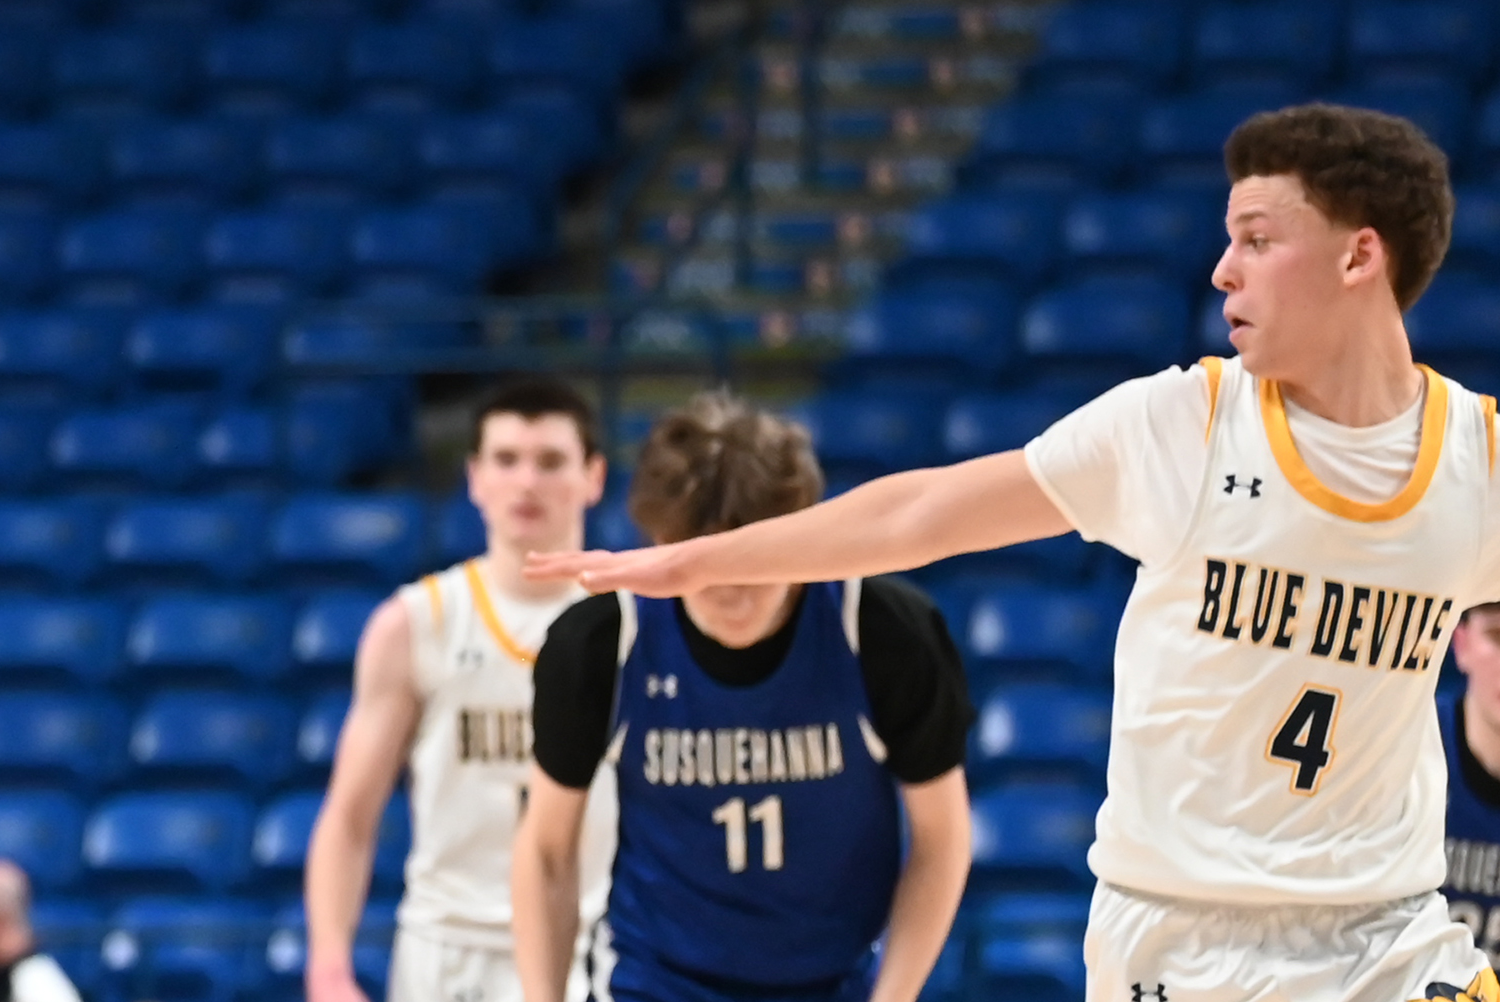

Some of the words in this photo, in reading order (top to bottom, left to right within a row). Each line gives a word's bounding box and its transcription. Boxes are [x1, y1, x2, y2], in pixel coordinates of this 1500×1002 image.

[1197, 556, 1306, 651] BLUE
[644, 722, 844, 787] SUSQUEHANNA
[1264, 683, 1343, 796] 4
[712, 794, 784, 873] 11
